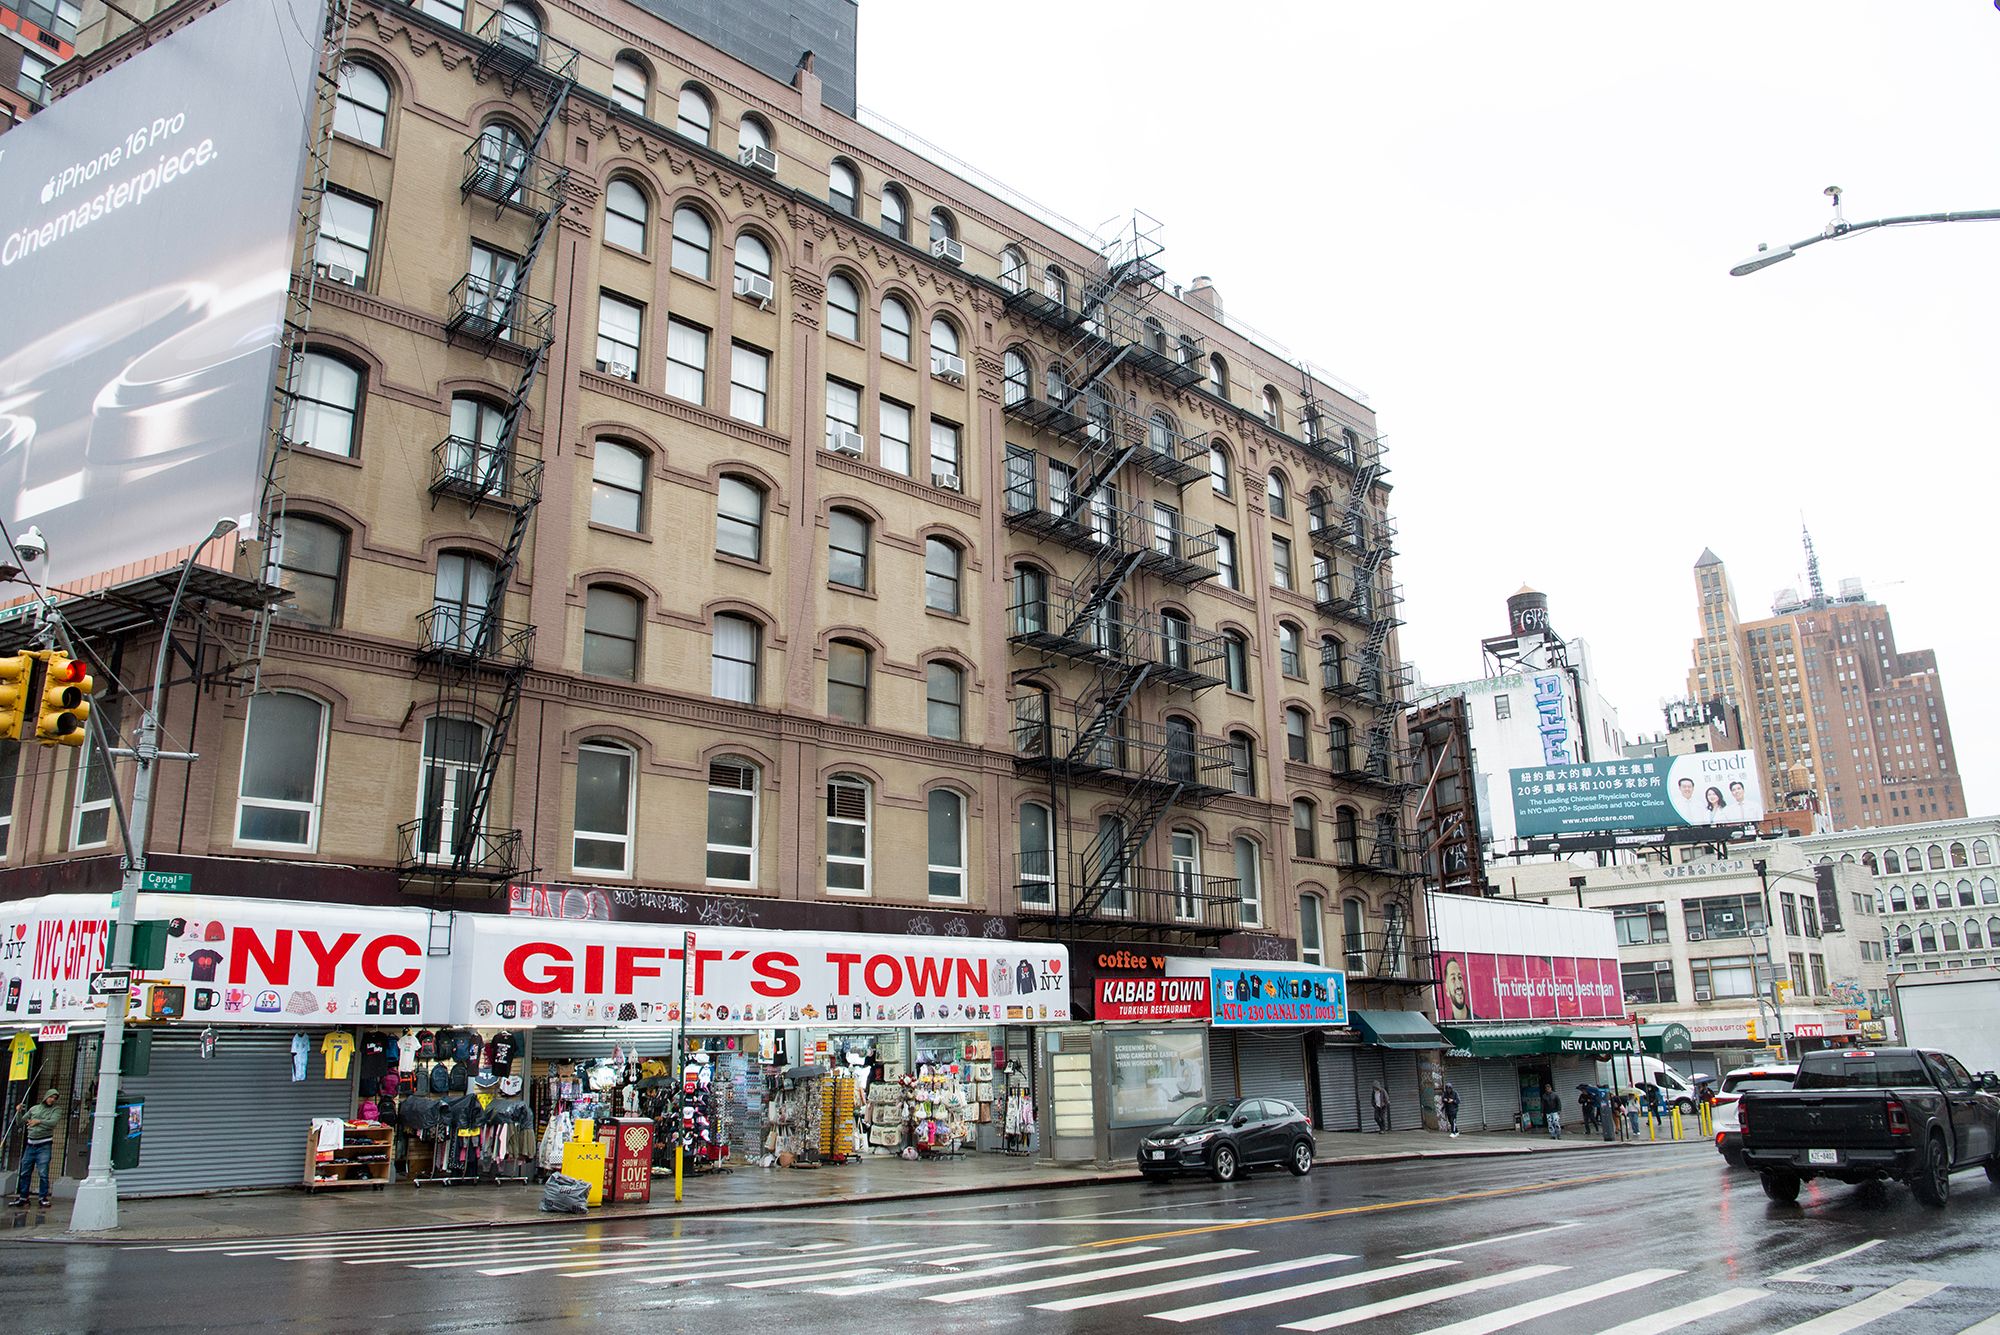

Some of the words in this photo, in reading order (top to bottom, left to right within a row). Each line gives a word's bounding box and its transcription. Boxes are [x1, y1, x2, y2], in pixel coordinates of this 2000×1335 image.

[55, 146, 122, 198] iPhone
[125, 127, 148, 159] 16
[149, 112, 185, 147] Pro
[1, 138, 218, 266] Cinemasterpiece.
[1702, 754, 1746, 772] rendr
[1543, 797, 1570, 805] Leading
[1570, 794, 1597, 803] Chinese
[1598, 792, 1630, 802] Physician
[1630, 791, 1652, 800] Group
[1527, 807, 1542, 815] NYC
[1572, 802, 1609, 812] Specialties
[1642, 799, 1665, 807] Clinics
[1562, 814, 1635, 825] www.rendrcare.com
[148, 873, 177, 884] Canal
[8, 925, 15, 942] I
[4, 941, 26, 960] NY
[32, 919, 64, 981] NYC
[64, 919, 108, 981] GIFT'S
[228, 926, 423, 990] NYC
[503, 941, 801, 997] GIFT'S
[826, 952, 989, 998] TOWN
[1041, 960, 1048, 974] I
[1098, 950, 1147, 969] coffee
[95, 979, 106, 988] ONE
[113, 979, 126, 987] WAY
[1040, 975, 1063, 991] NY
[1493, 977, 1510, 996] I'm
[1510, 977, 1535, 997] tired
[1536, 978, 1546, 996] of
[1547, 977, 1575, 1001] being
[1574, 977, 1595, 997] best
[1595, 983, 1614, 997] man
[1103, 981, 1156, 1003] KABAB
[1161, 980, 1204, 1001] TOWN
[225, 1001, 242, 1011] NY
[1119, 1005, 1148, 1015] TURKISH
[1150, 1004, 1192, 1014] RESTAURANT
[1266, 1003, 1298, 1020] CANAL
[1300, 1003, 1312, 1020] ST.
[1315, 1006, 1336, 1020] 10013
[41, 1025, 66, 1035] ATM
[1797, 1026, 1822, 1037] ATM
[333, 1045, 343, 1061] 7
[1561, 1040, 1583, 1050] NEW
[1584, 1040, 1611, 1051] LAND
[1613, 1040, 1647, 1051] PLAA
[622, 1159, 639, 1167] SHOW
[621, 1167, 648, 1182] LOVE
[630, 1182, 647, 1190] CLEAN
